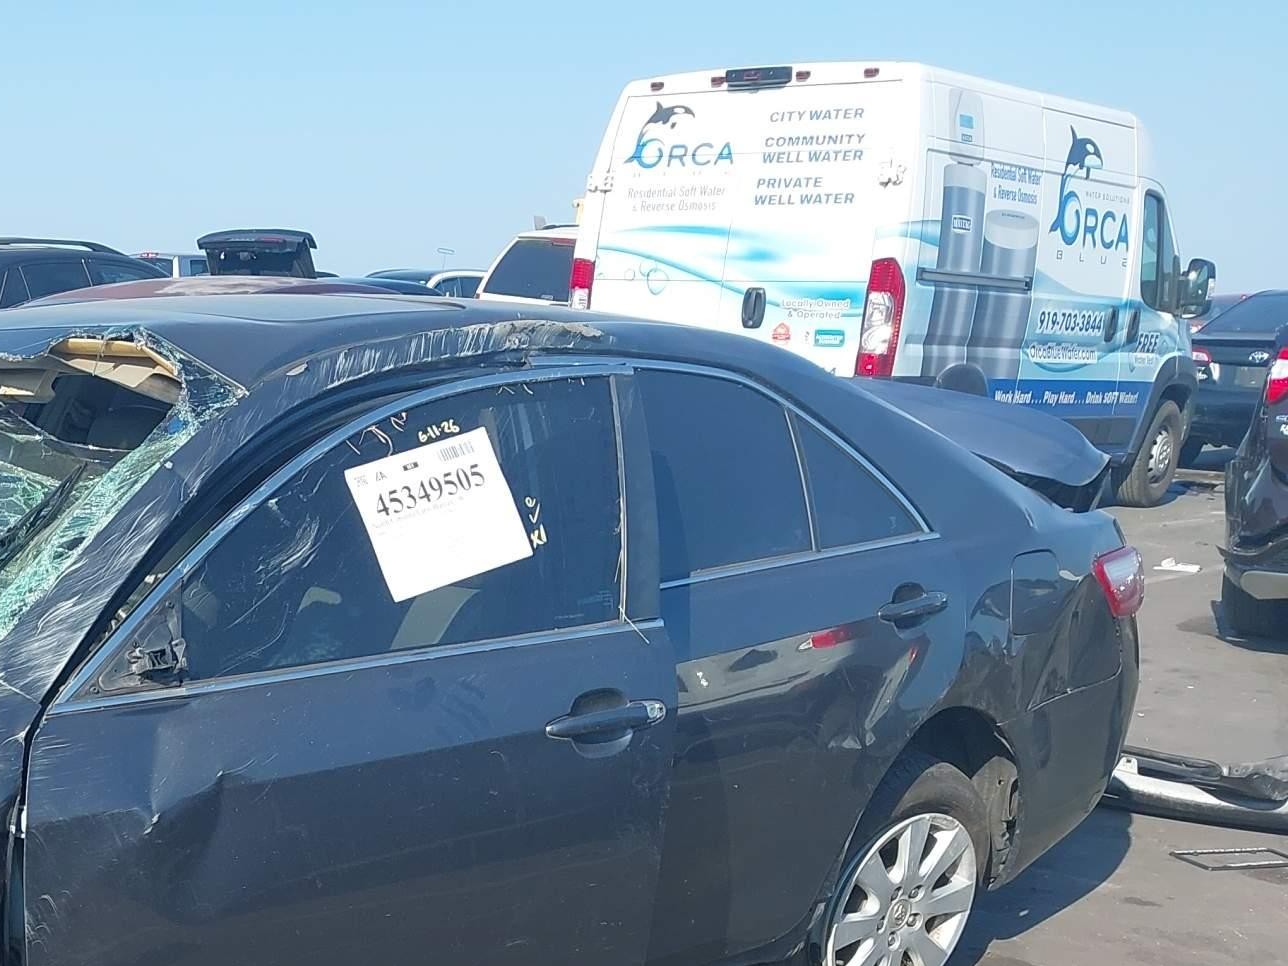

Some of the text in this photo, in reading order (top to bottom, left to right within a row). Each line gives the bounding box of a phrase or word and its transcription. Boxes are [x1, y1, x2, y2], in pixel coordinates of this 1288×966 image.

[769, 107, 865, 123] CITY WATER
[764, 133, 866, 148] COMMUNITY
[636, 137, 734, 170] ORCA
[762, 149, 864, 164] WELL WATER
[991, 163, 1016, 181] Residential
[1017, 166, 1028, 183] Soft
[756, 176, 824, 189] PRIVATE
[626, 184, 726, 199] Residential Soft Water
[754, 192, 855, 206] WELL WATER
[998, 184, 1017, 201] Reverse
[1017, 187, 1038, 204] Osmosis
[640, 200, 677, 213] Reverse
[678, 199, 717, 211] Osmosis
[1059, 190, 1129, 253] ORCA
[781, 298, 850, 309] Locally Owned
[796, 310, 841, 319] Operated
[1038, 311, 1103, 333] 919-703-3844
[1136, 333, 1160, 353] FREE
[994, 390, 1013, 403] Work
[1043, 391, 1058, 407] Play
[1085, 391, 1103, 404] Drink
[1103, 391, 1119, 405] SOFT
[376, 463, 486, 517] 45349505
